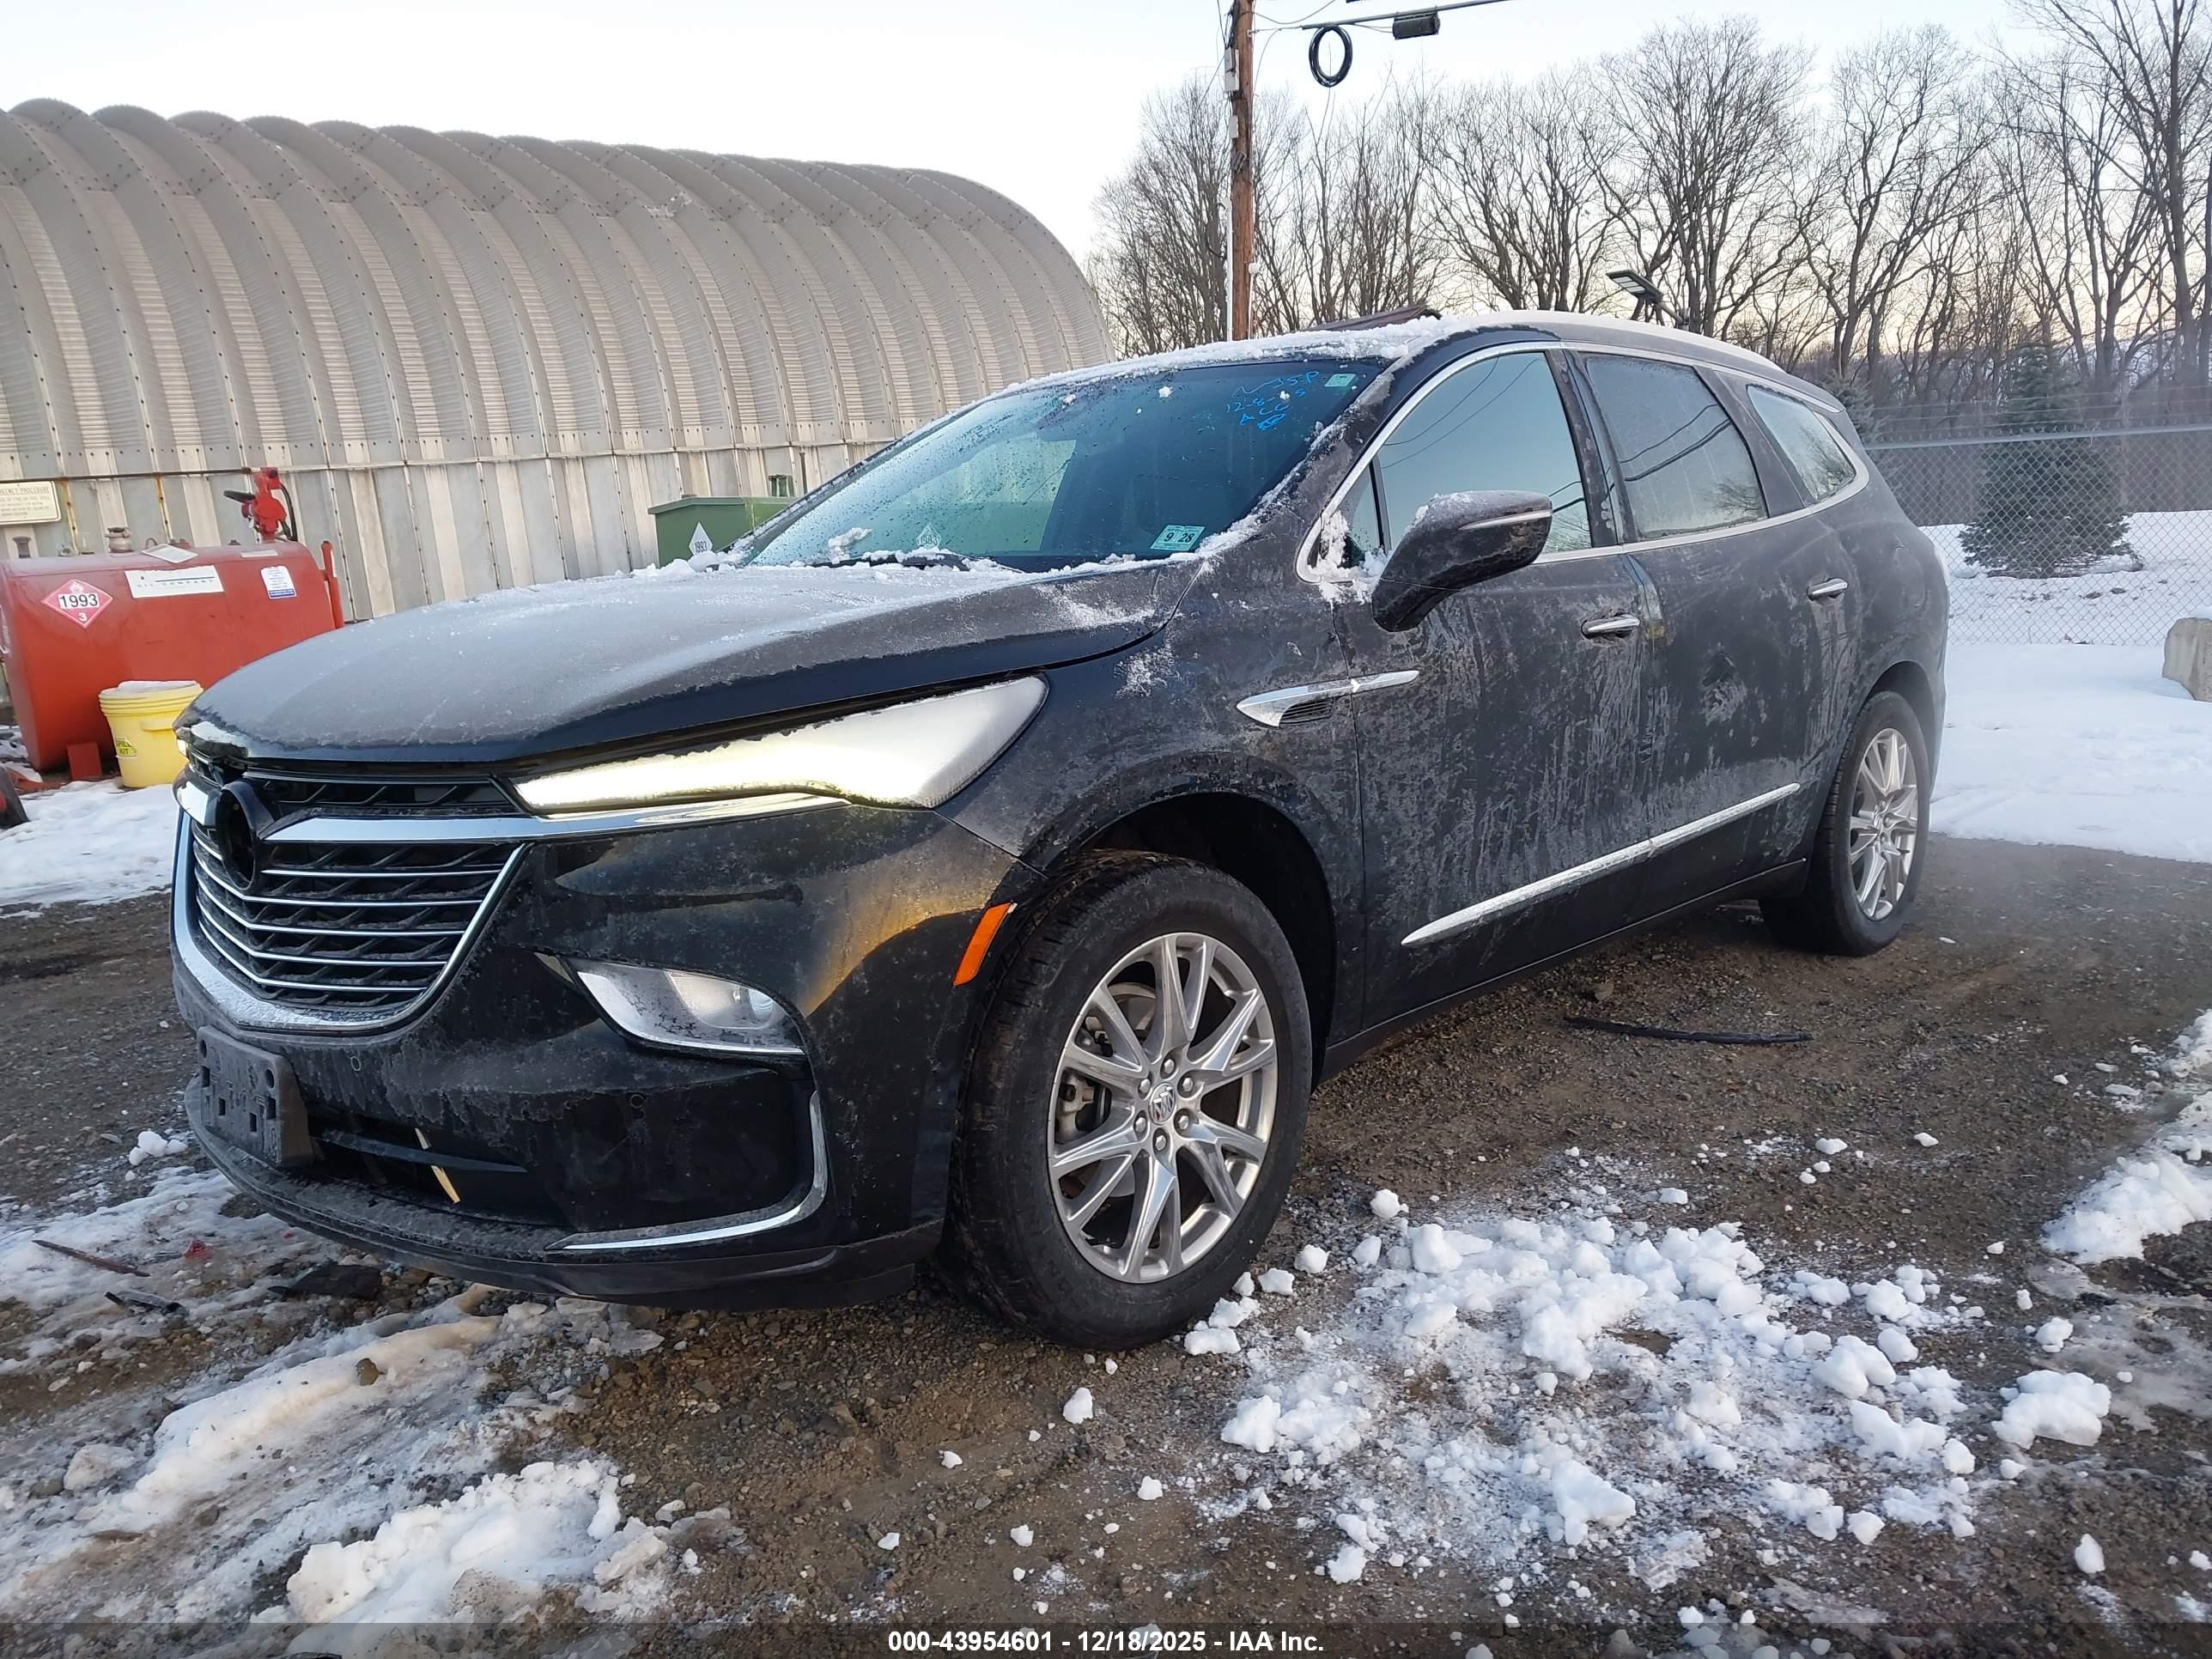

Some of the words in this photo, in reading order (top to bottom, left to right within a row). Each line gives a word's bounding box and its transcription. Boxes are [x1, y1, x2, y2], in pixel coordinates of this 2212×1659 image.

[1164, 532, 1175, 542] 9
[1177, 532, 1195, 543] 28
[59, 593, 98, 607] 1993
[78, 612, 88, 622] 3
